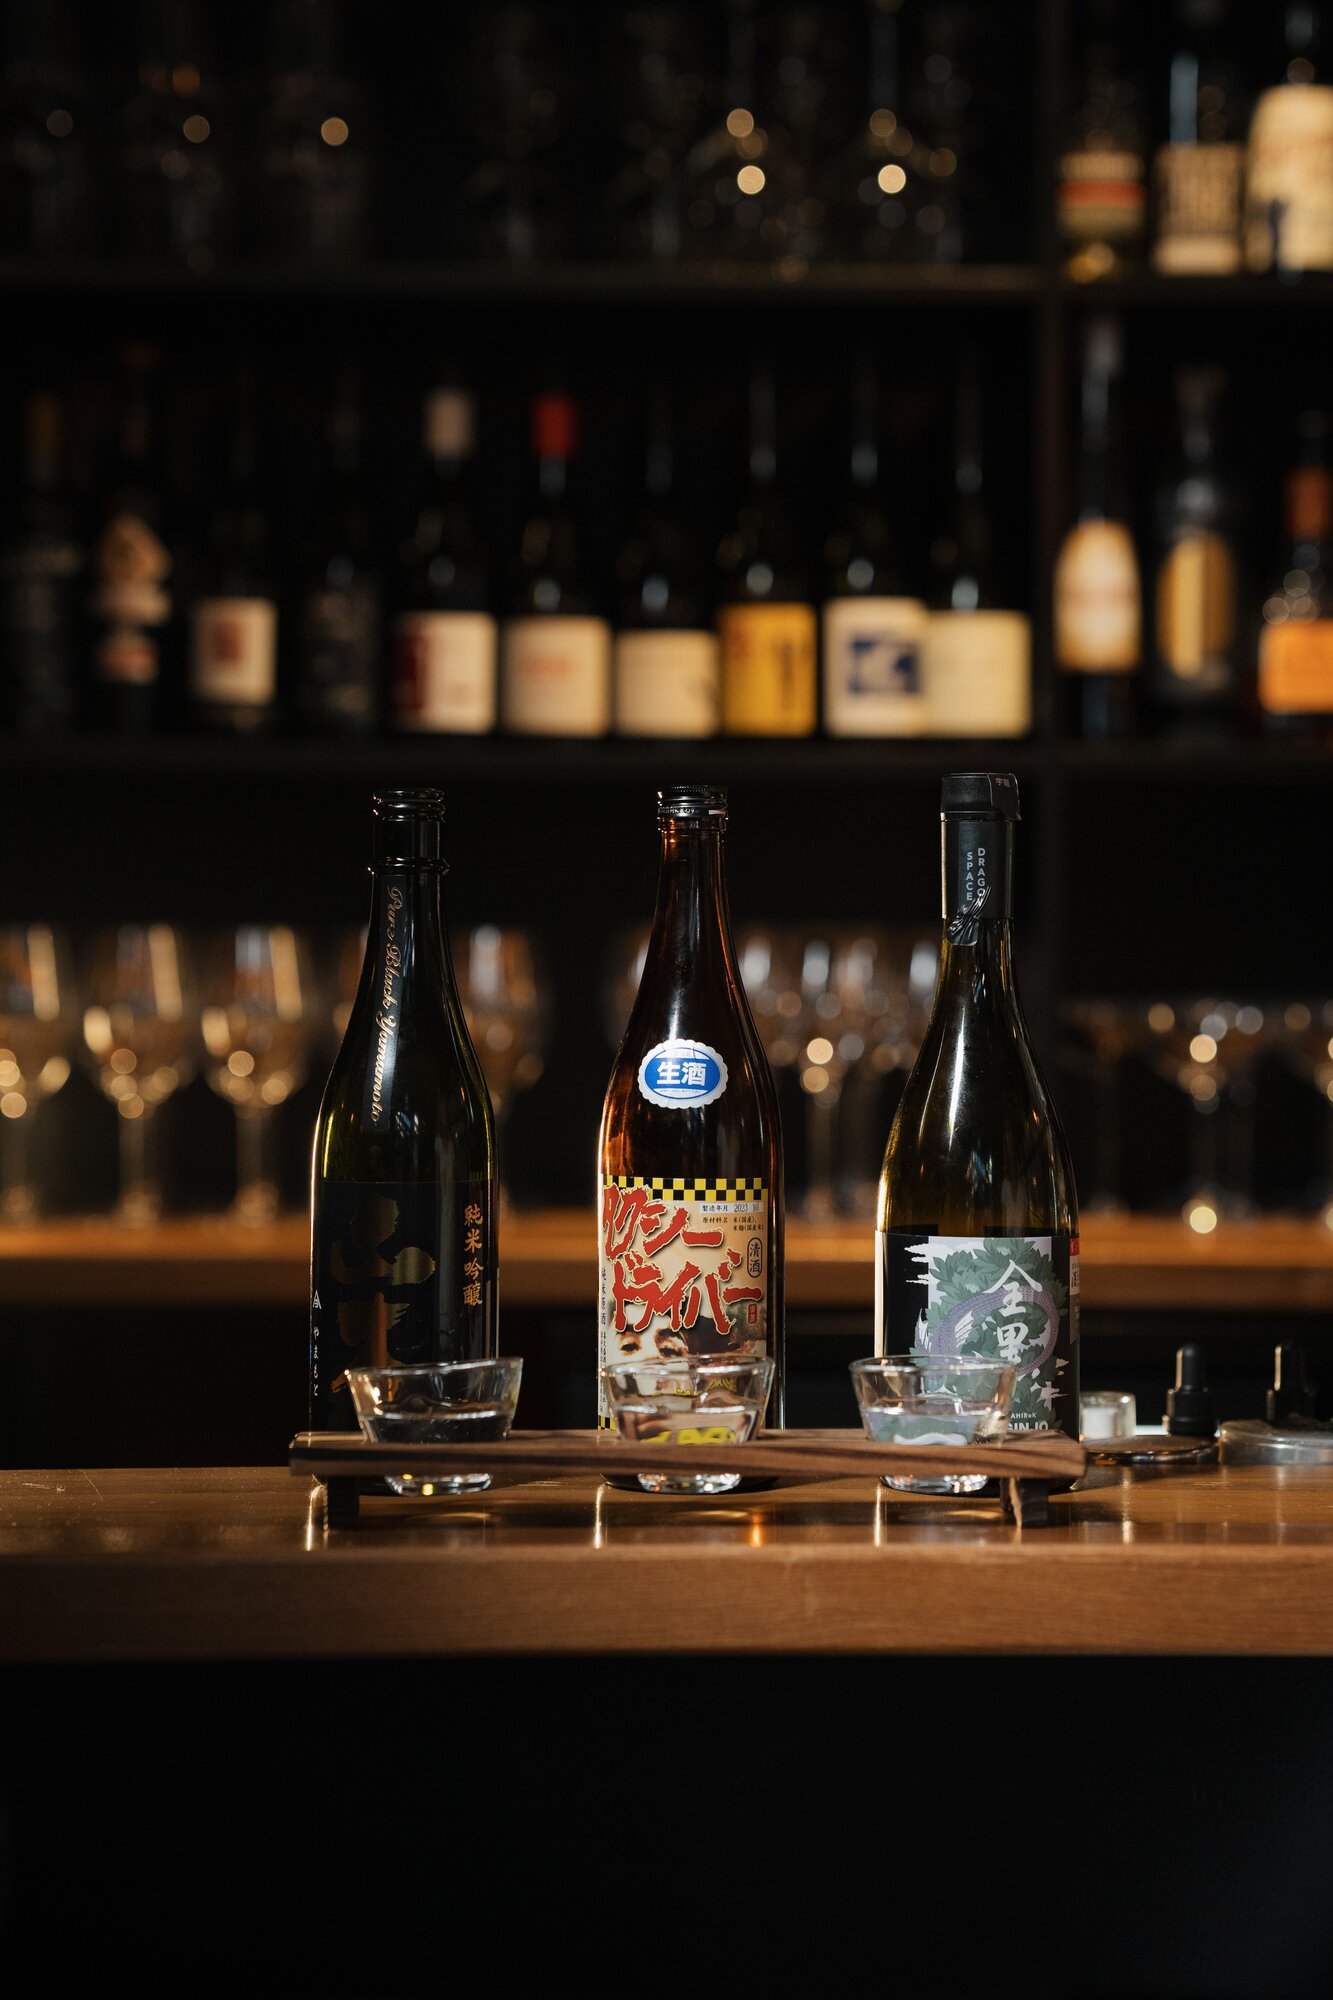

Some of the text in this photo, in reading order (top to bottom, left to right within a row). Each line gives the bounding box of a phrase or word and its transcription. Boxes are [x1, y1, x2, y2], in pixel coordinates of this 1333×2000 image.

[966, 851, 974, 901] SPACE
[382, 943, 402, 1008] Black
[370, 1010, 398, 1122] Yamamoto
[656, 1061, 707, 1086] 生酒
[463, 1203, 484, 1307] 純米吟醸
[749, 1242, 760, 1273] 清酒
[612, 1247, 763, 1335] ドライバー
